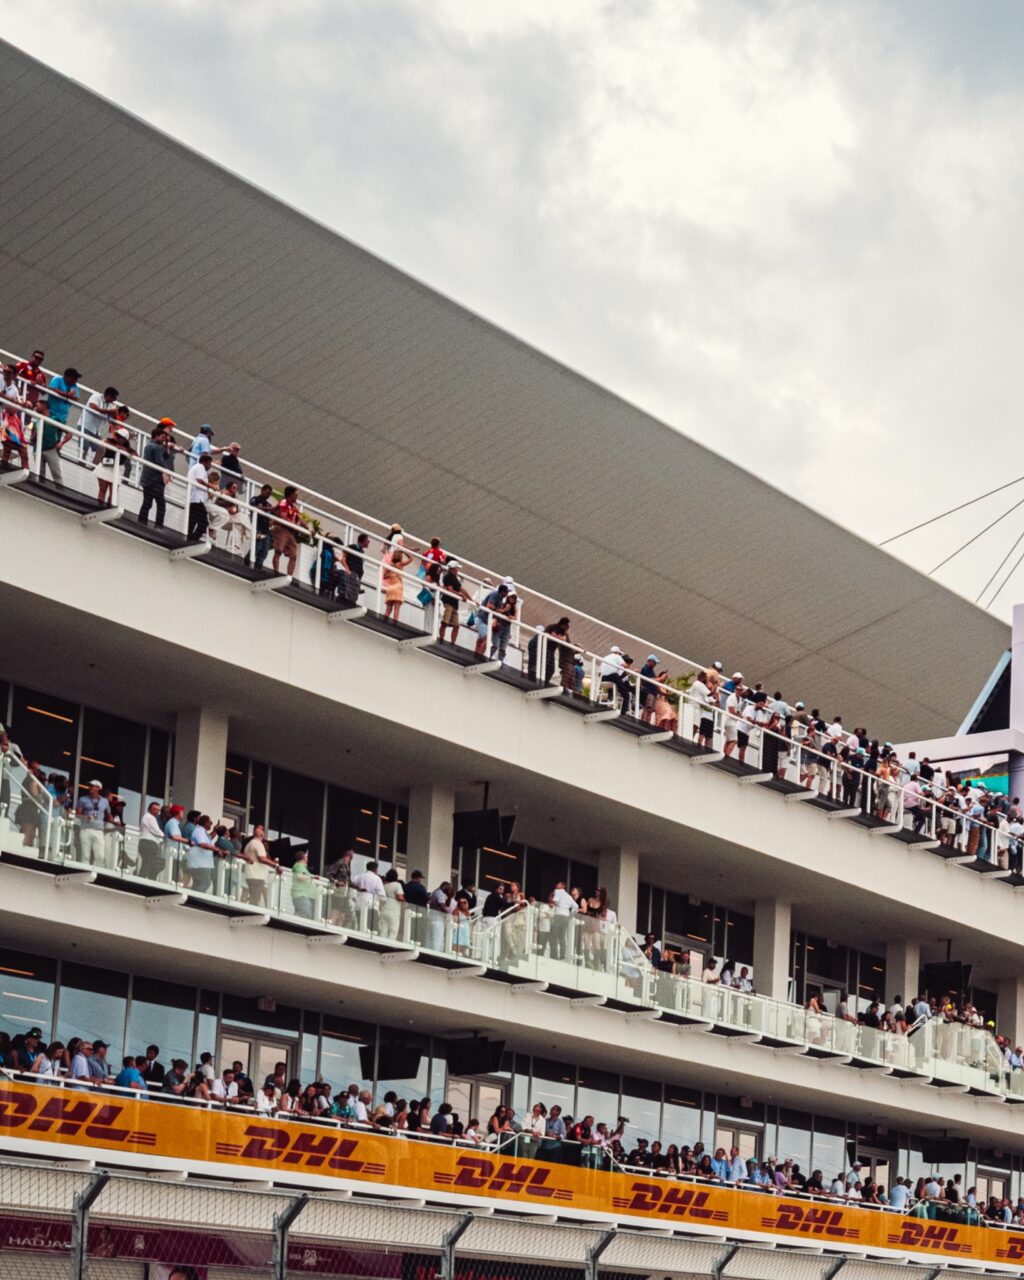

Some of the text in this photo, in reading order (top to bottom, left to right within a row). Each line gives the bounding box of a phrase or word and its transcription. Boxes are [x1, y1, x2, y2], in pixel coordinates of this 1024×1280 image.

[0, 1090, 131, 1142] DHL
[240, 1125, 365, 1172] DHL
[453, 1156, 555, 1201] DHL
[628, 1182, 714, 1219] DHL
[776, 1204, 846, 1237] DHL
[899, 1222, 962, 1251] DHL
